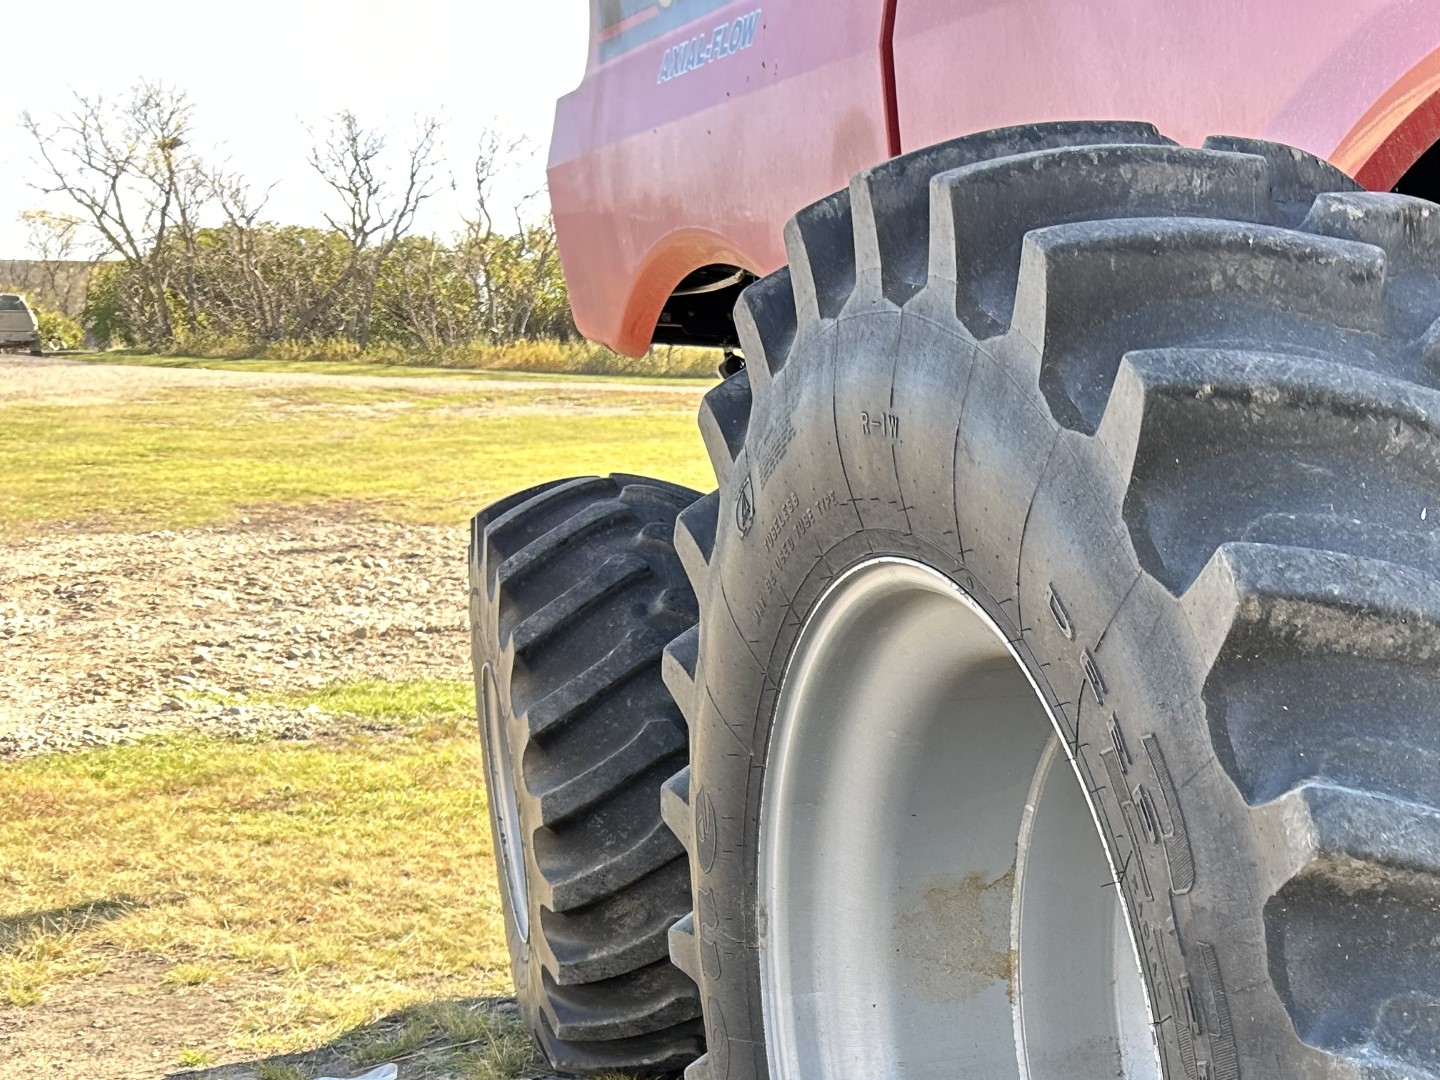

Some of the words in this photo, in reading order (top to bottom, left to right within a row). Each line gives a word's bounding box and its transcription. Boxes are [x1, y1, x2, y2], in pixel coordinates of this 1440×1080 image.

[656, 8, 762, 85] AXIAL-FLOW
[861, 411, 900, 440] R-1W
[752, 597, 769, 627] MAY
[764, 570, 778, 593] BE
[775, 538, 796, 573] USED
[792, 507, 817, 537] TUBE
[814, 490, 838, 518] TYPE
[762, 491, 800, 552] TUBELESS
[1130, 873, 1164, 1001] RADIAL
